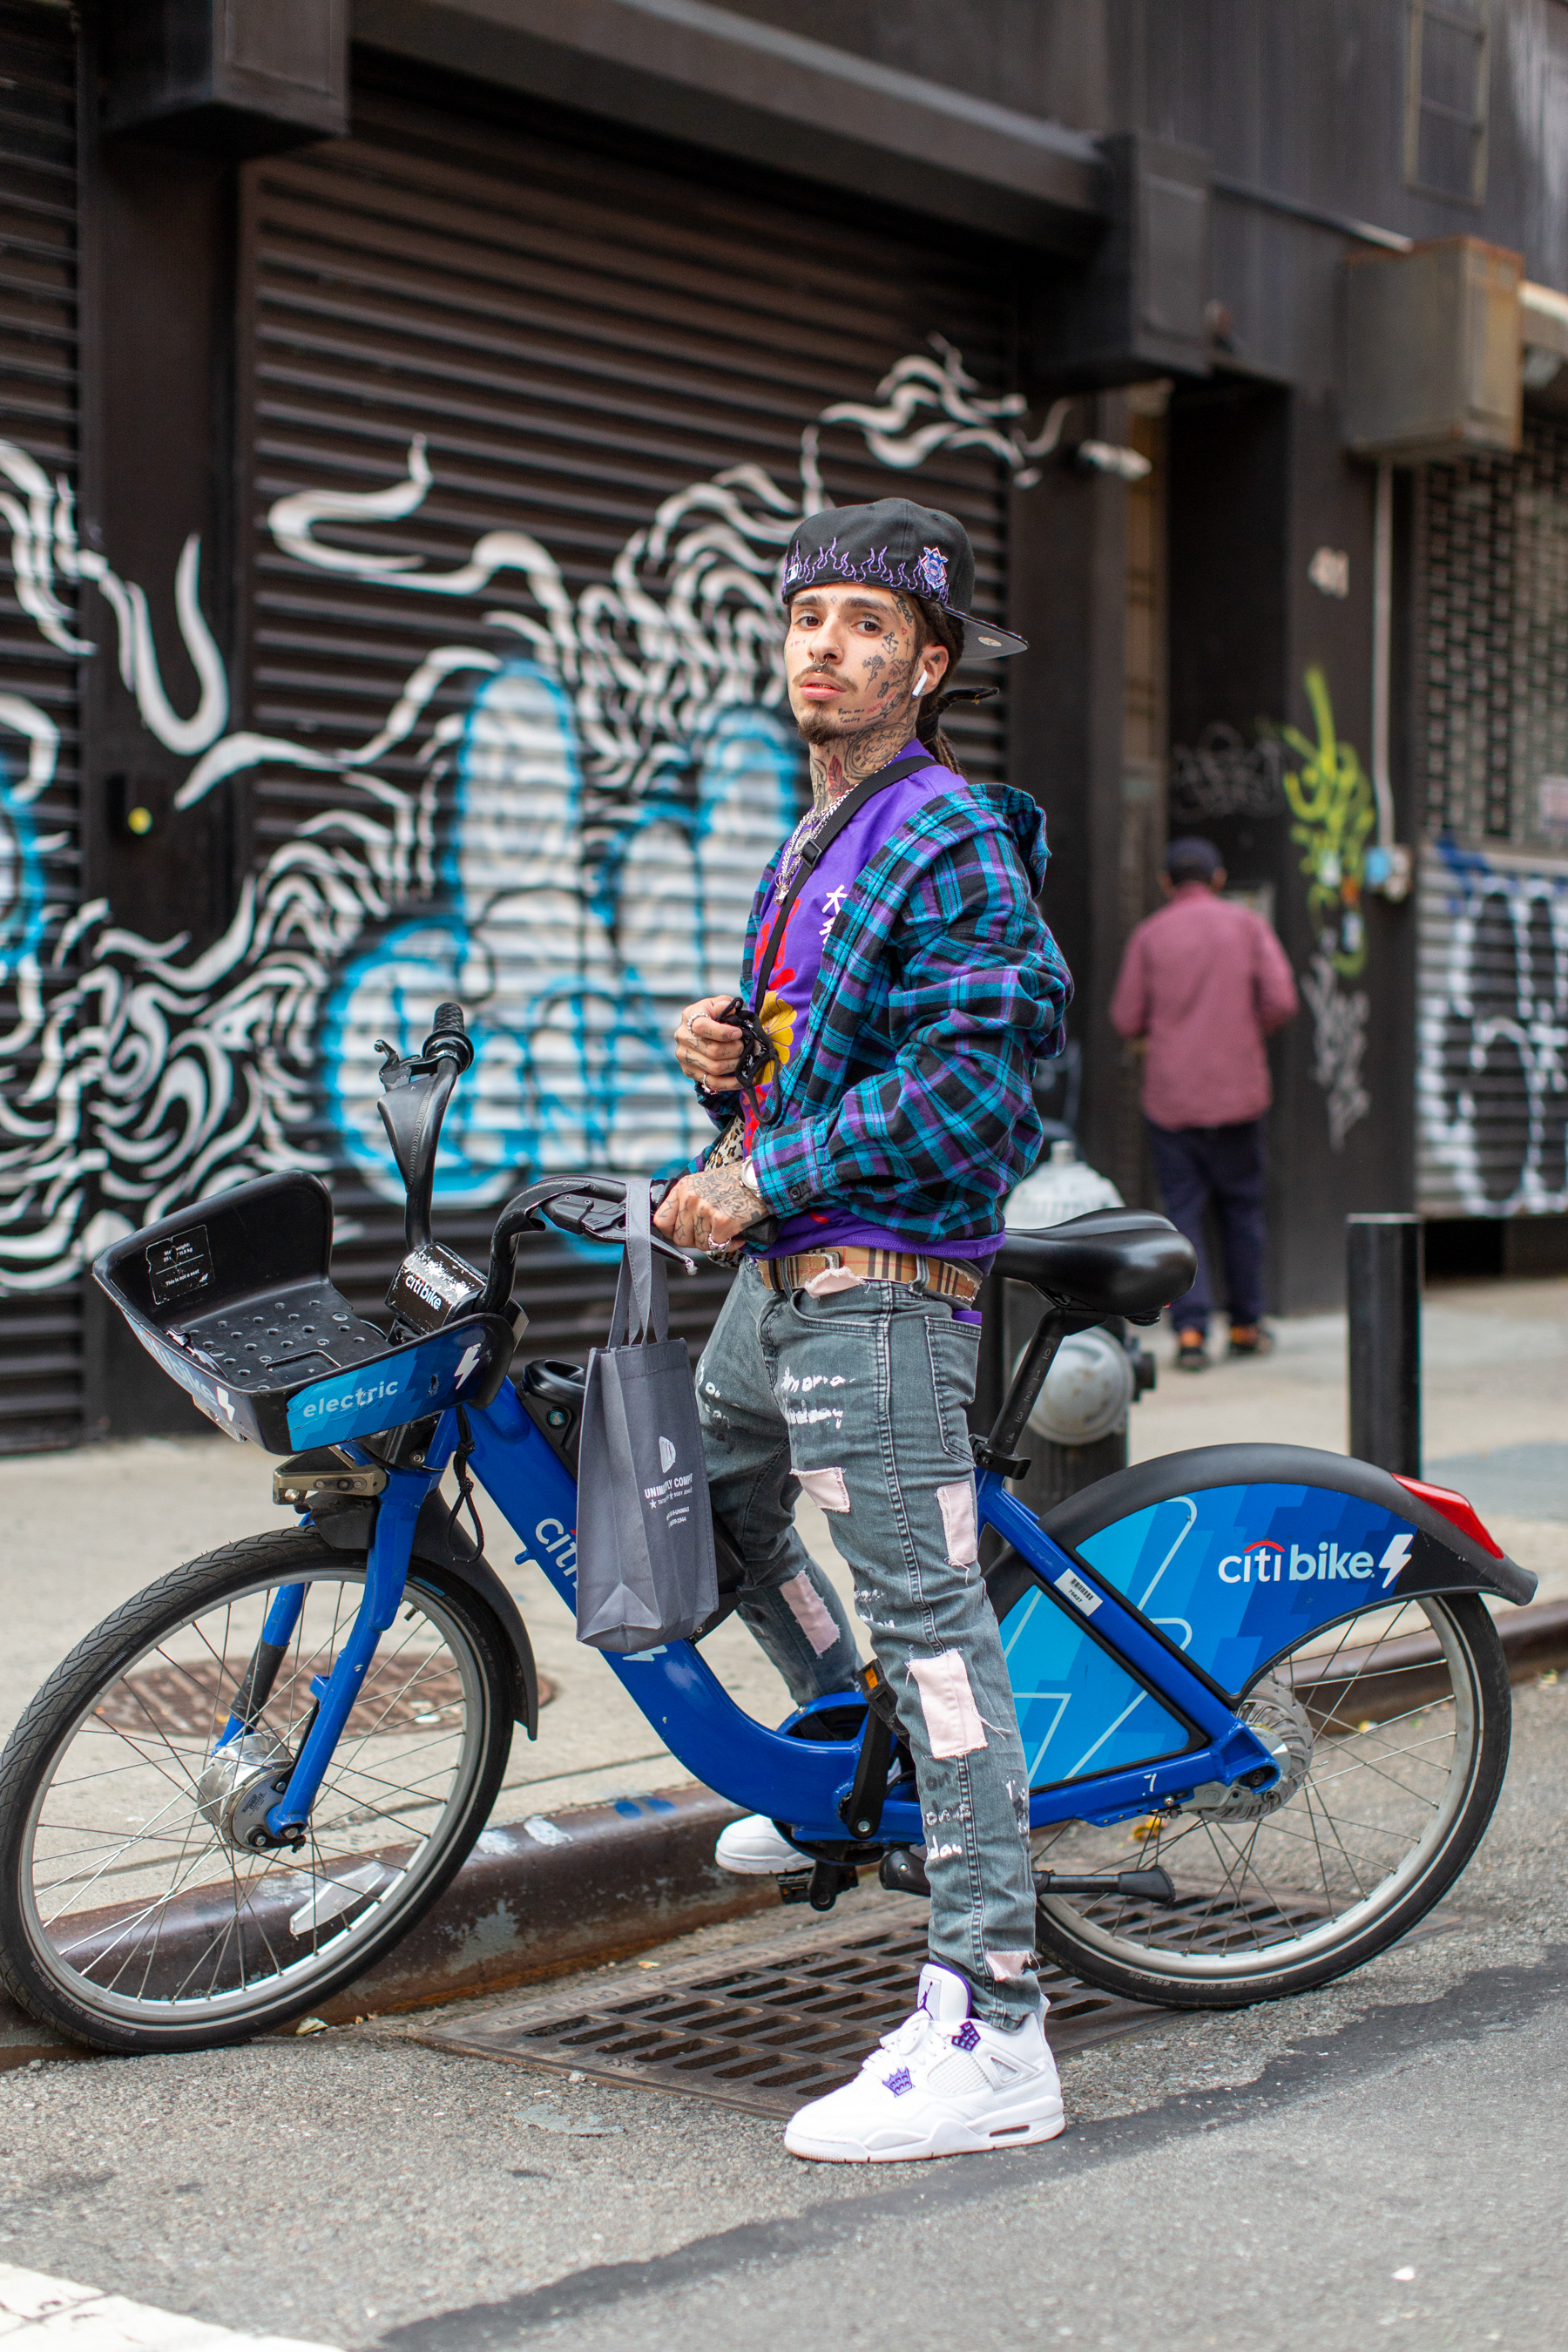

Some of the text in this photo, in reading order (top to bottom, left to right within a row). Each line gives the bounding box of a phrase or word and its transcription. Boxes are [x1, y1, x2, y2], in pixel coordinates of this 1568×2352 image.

[420, 1284, 442, 1310] bike
[303, 1381, 399, 1418] electric
[1218, 1540, 1375, 1584] citi bike
[1068, 1588, 1083, 1603] 76627
[30, 1960, 55, 1991] 50-559
[1127, 1970, 1171, 1987] 50-559
